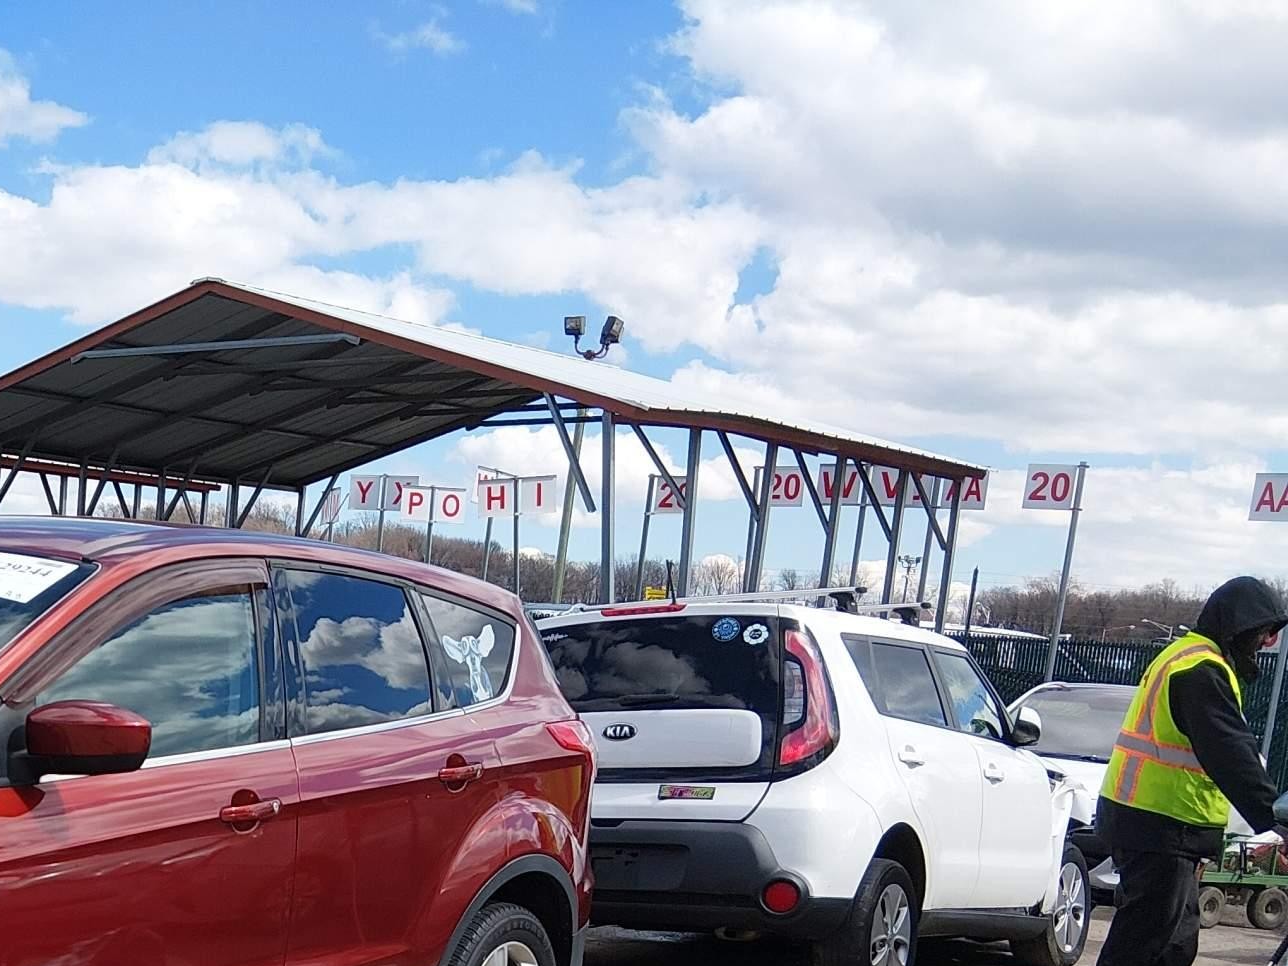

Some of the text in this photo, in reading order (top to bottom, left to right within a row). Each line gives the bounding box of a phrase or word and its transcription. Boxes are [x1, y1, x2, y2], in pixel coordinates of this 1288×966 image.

[357, 481, 373, 504] Y
[487, 485, 505, 510] H
[536, 482, 542, 507] I
[772, 473, 801, 500] 20
[1028, 472, 1070, 501] 20
[408, 492, 423, 515] P
[606, 726, 631, 737] KIA
